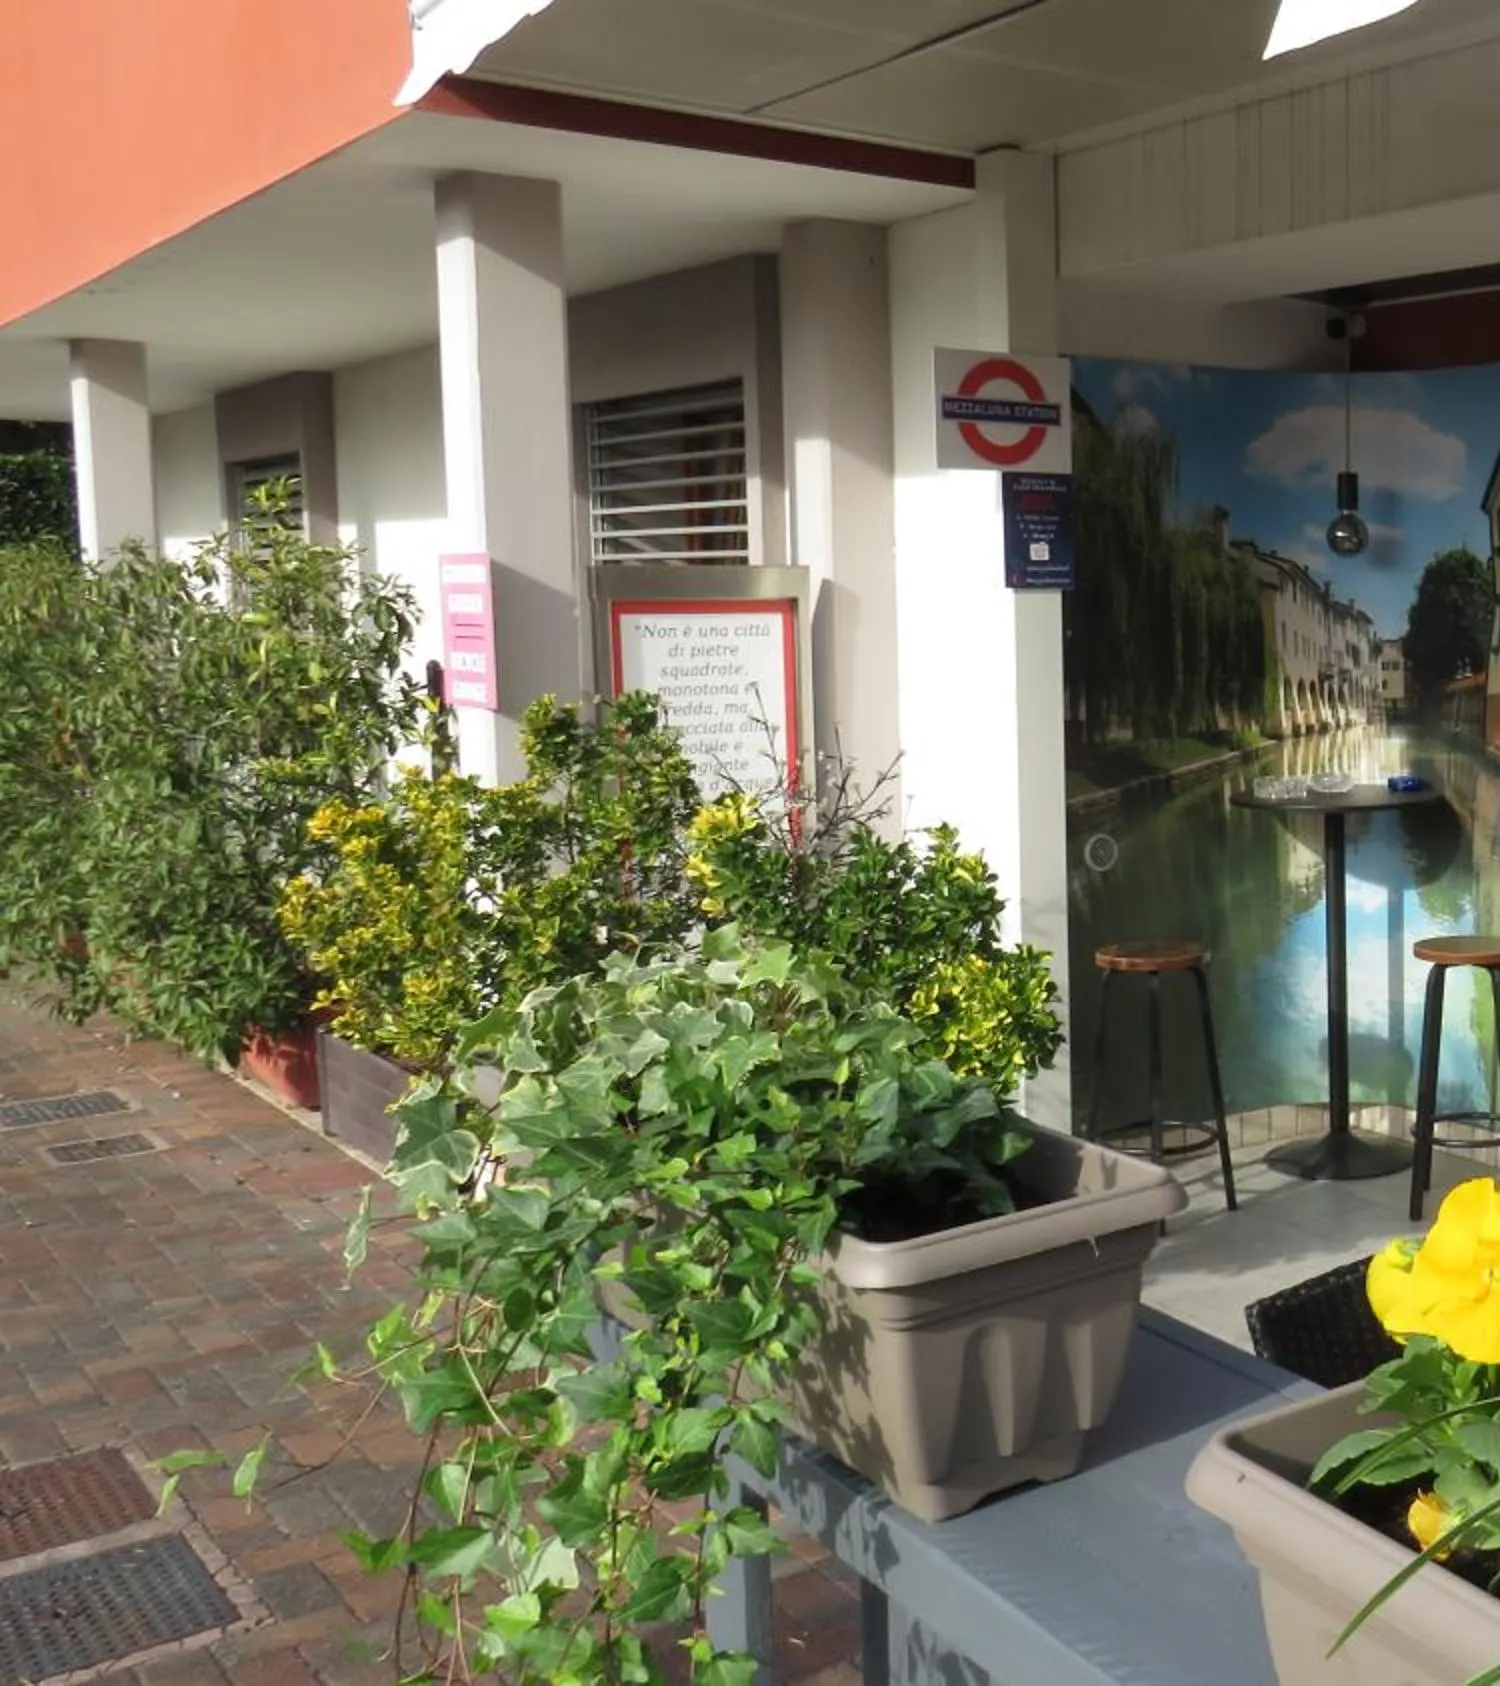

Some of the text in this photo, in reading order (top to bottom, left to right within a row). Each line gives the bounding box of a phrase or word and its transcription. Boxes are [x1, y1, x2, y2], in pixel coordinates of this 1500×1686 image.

[699, 626, 729, 637] una
[668, 643, 740, 659] di pietre
